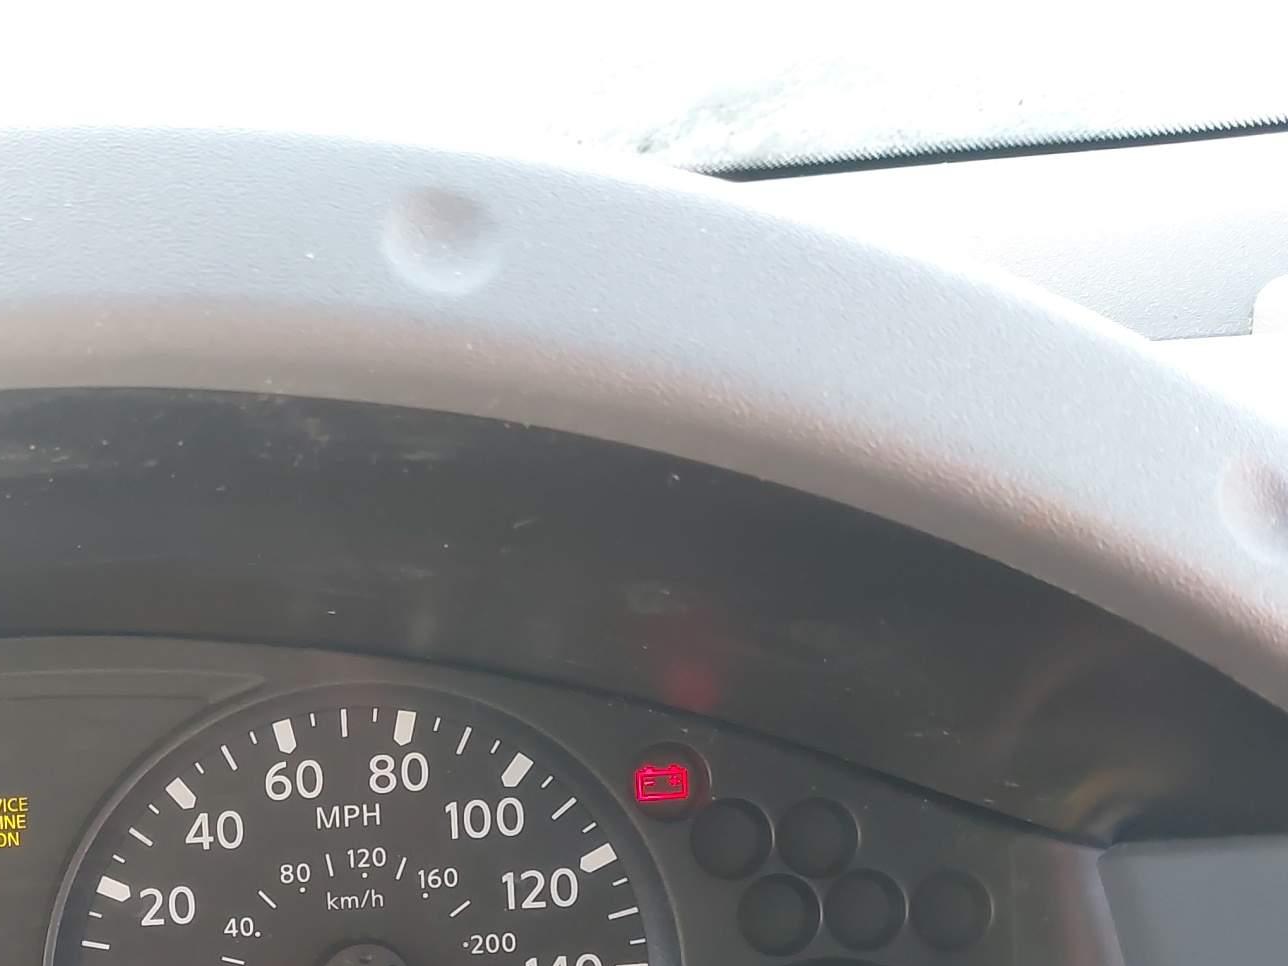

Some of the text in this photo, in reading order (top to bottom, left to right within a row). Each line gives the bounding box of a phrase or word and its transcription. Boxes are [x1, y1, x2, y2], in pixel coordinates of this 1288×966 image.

[266, 759, 325, 801] 60
[369, 752, 429, 792] 80
[184, 810, 244, 850] 40
[316, 803, 382, 830] MPH
[444, 797, 526, 840] 100
[346, 846, 387, 870] 120
[280, 860, 311, 885] 80
[418, 867, 459, 890] 160
[326, 887, 384, 911] km/h
[502, 869, 579, 909] 120
[140, 885, 196, 926] 20
[223, 916, 254, 937] 40
[470, 932, 516, 954] 200
